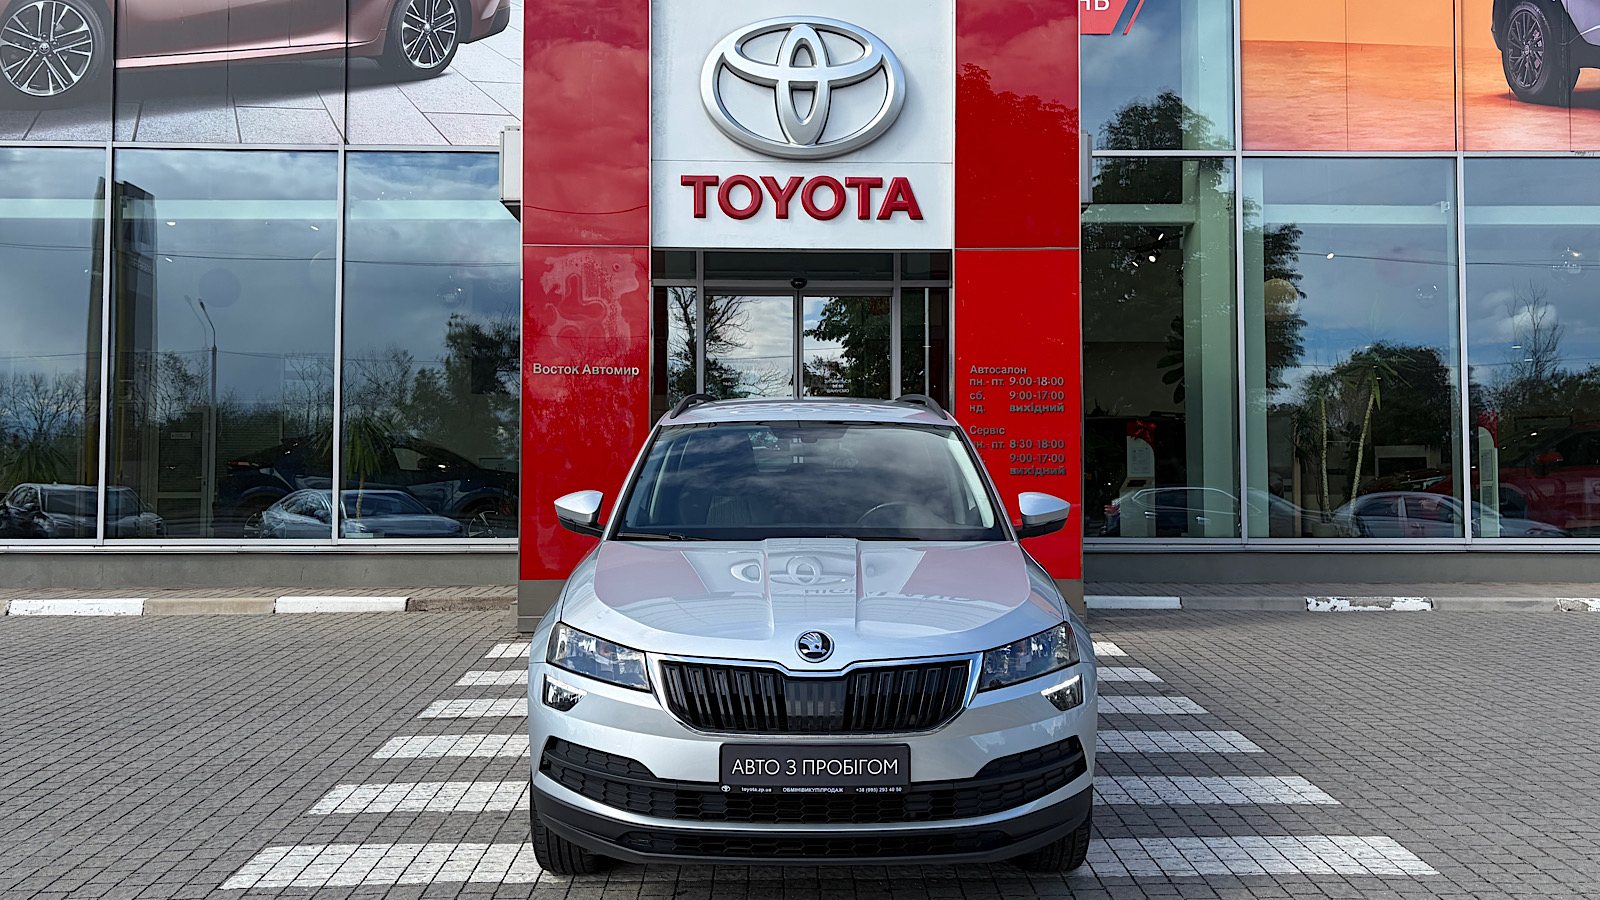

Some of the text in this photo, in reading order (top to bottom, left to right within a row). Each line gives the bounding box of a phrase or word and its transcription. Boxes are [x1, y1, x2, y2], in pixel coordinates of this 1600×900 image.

[681, 174, 924, 221] TOYOTA
[533, 363, 640, 377] Восток Автомир
[970, 365, 1027, 375] Автосалон
[1009, 377, 1065, 386] 9:00-18:00
[970, 391, 1065, 400] сб. 9:00-17:00
[970, 403, 1065, 413] нд. вихідний
[970, 425, 1006, 437] Сервіс
[1009, 454, 1066, 463] 9:00-17:00
[1010, 465, 1066, 476] вихідний
[731, 759, 898, 775] АВТО З ПРОБІГОМ
